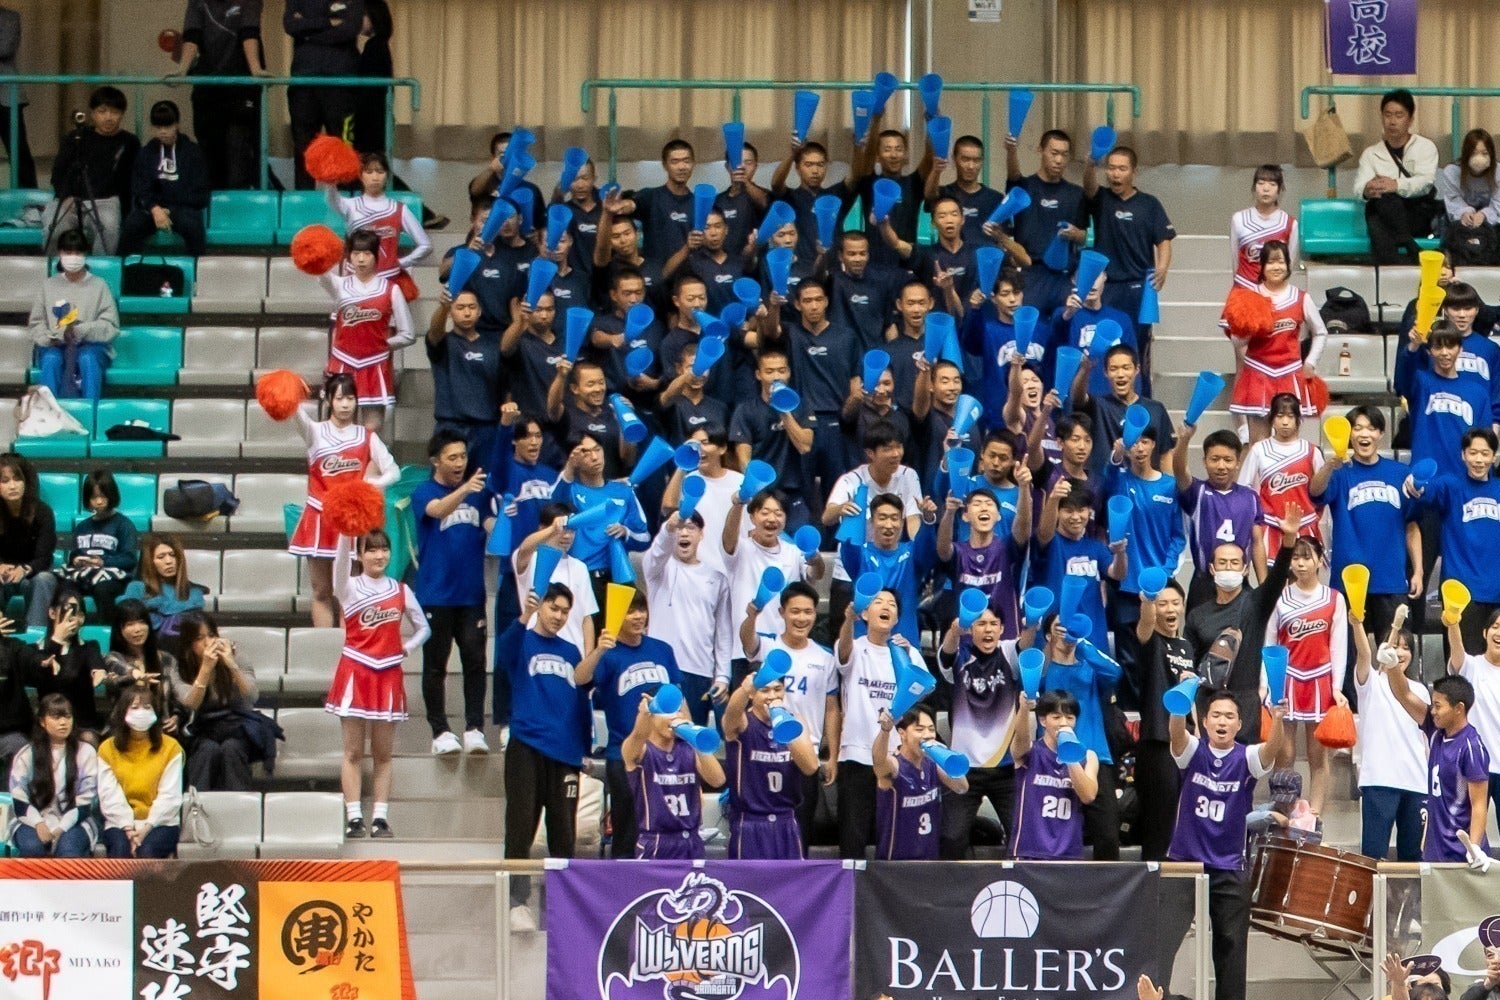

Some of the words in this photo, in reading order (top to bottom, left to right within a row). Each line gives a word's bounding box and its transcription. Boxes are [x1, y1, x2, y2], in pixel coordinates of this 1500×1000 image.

[321, 455, 362, 477] Chuo
[1269, 471, 1309, 496] Chuo
[1216, 519, 1235, 542] 4
[359, 605, 400, 631] Chuo
[1288, 617, 1329, 641] Chuo
[750, 749, 793, 762] HORNET
[902, 788, 939, 808] HORNET
[1041, 795, 1072, 820] 20
[1194, 795, 1226, 822] 30
[918, 813, 932, 836] 3
[195, 882, 251, 991] 堅守
[352, 902, 376, 973] やかた
[69, 957, 121, 968] MIYAKO
[888, 936, 1126, 992] BALLER'S
